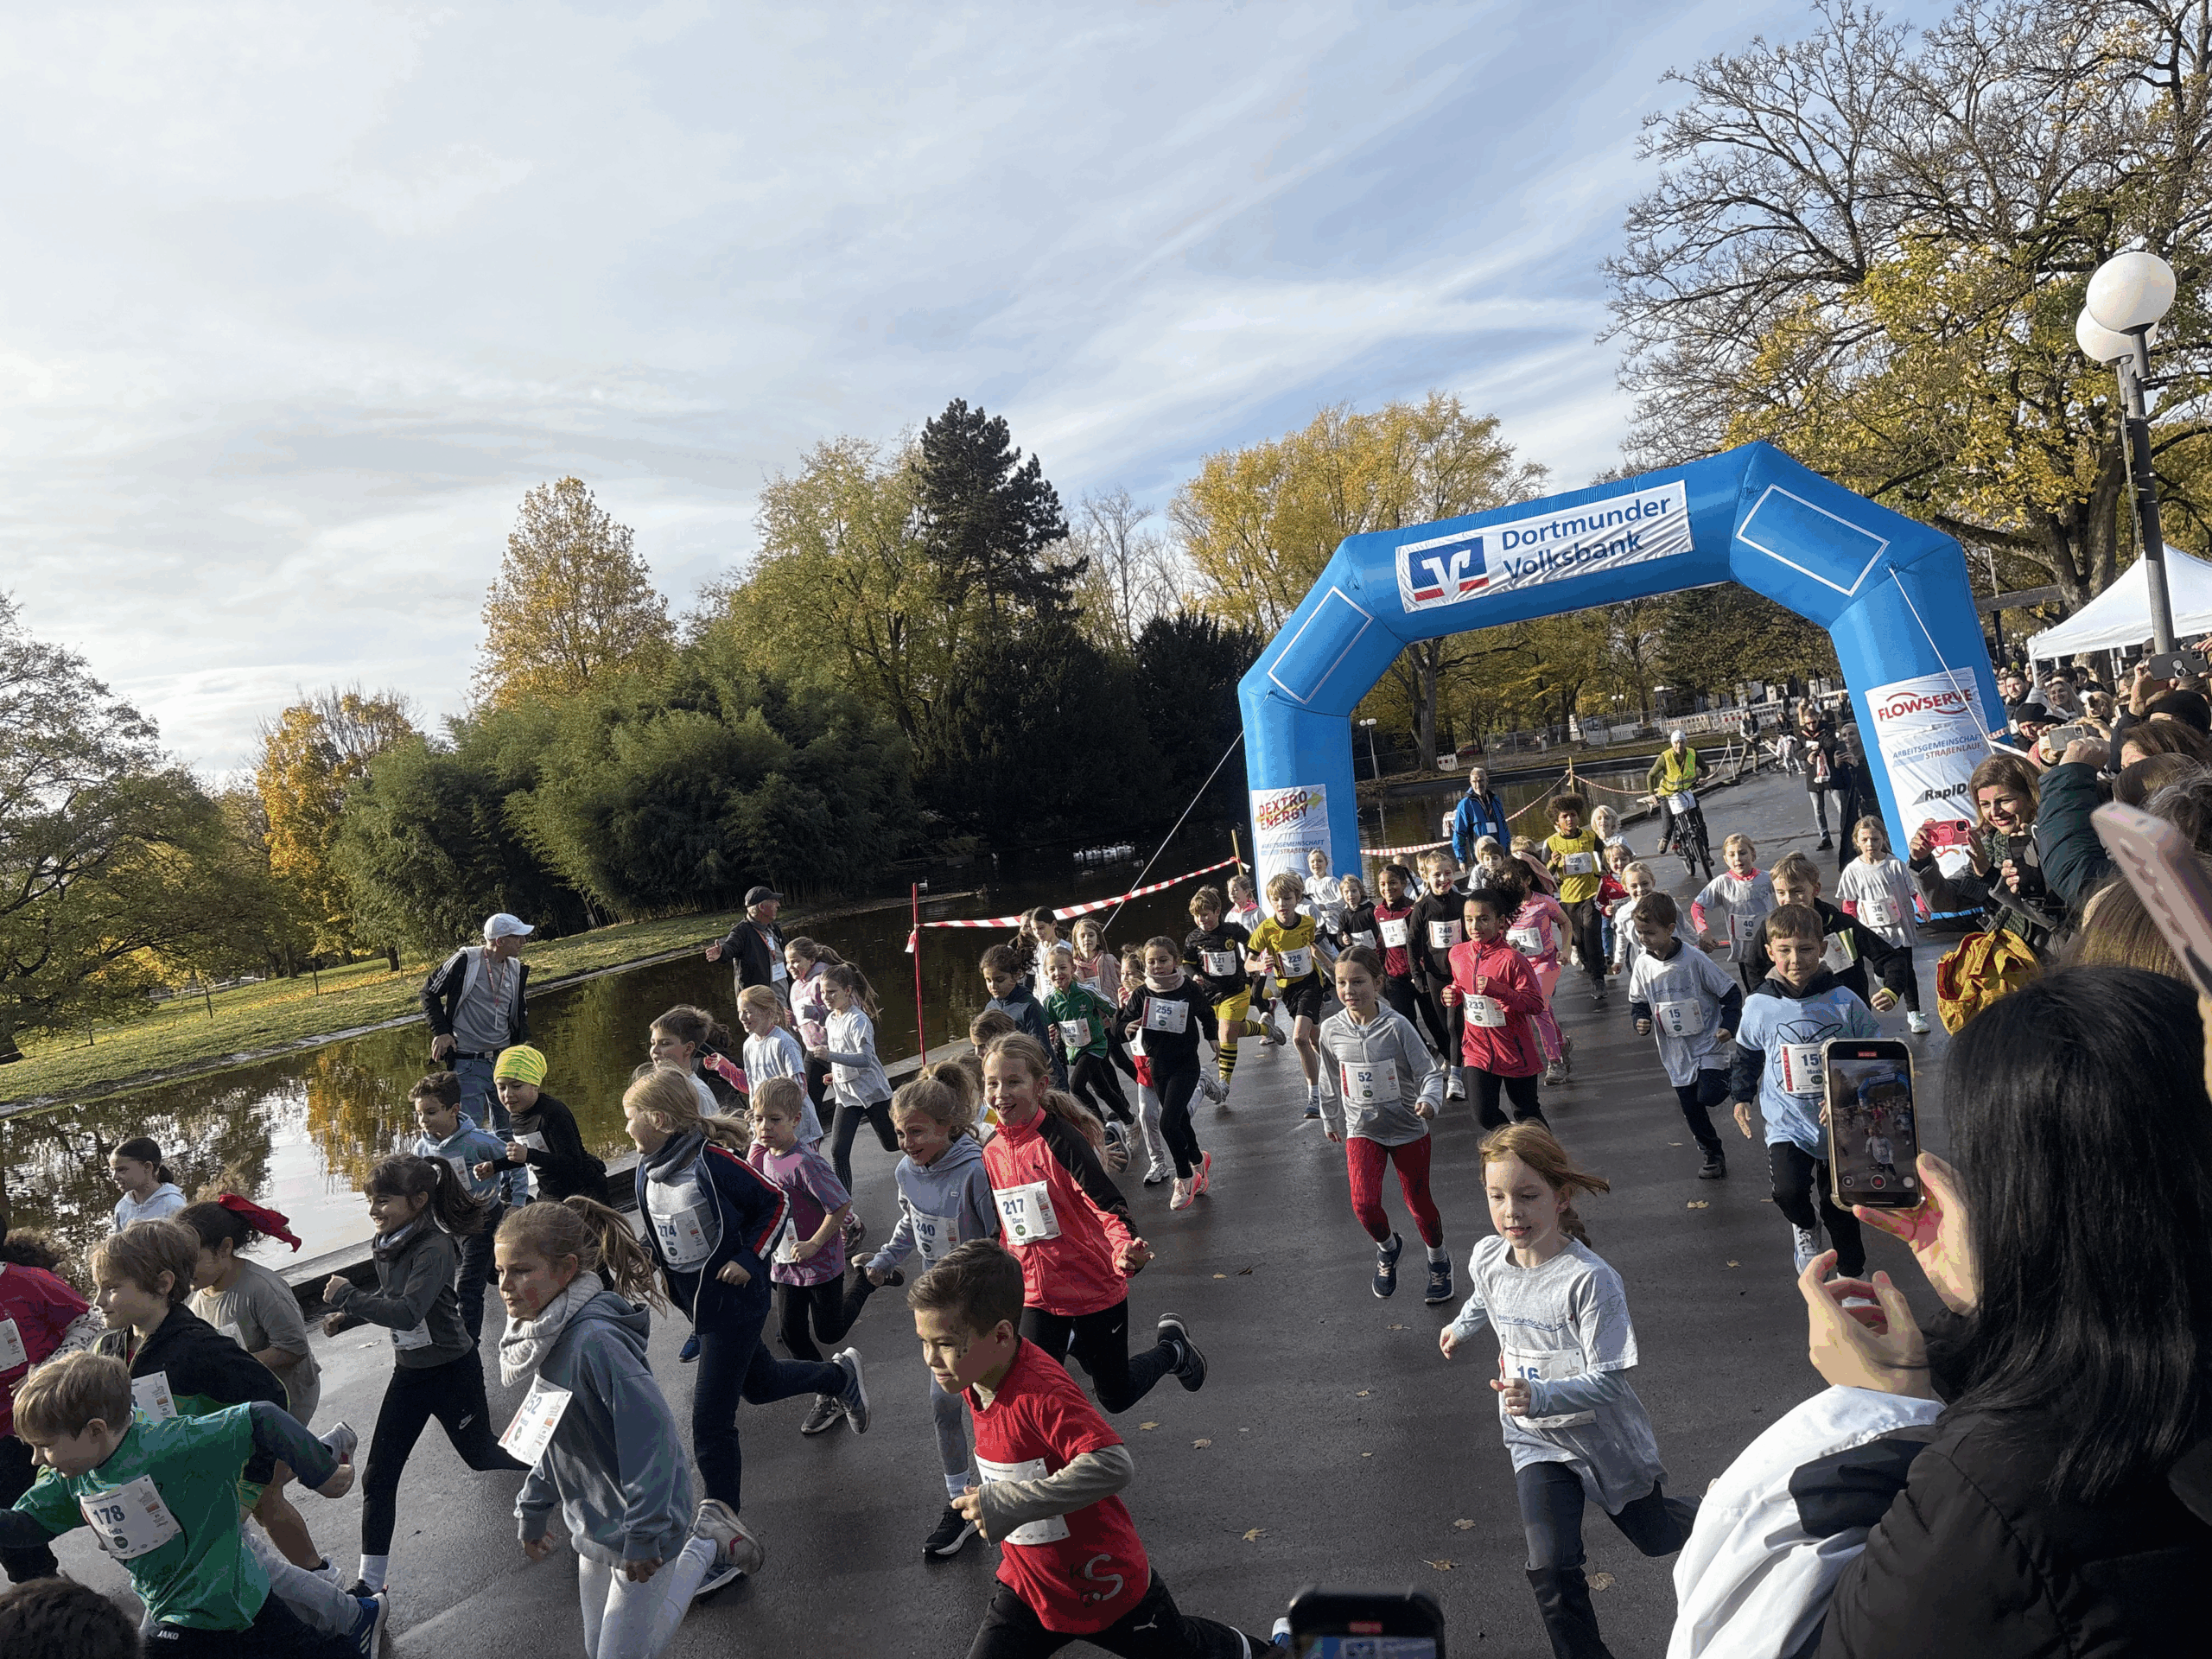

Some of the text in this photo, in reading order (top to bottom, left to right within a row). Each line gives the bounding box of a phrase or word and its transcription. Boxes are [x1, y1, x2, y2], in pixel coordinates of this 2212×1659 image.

[1503, 496, 1671, 551] Dortmunder
[1503, 531, 1644, 580] Volksbank
[1878, 689, 1974, 721] FLOWSERVE
[1892, 734, 1983, 759] ARBEITSGEMEINSCHAFT
[1258, 791, 1308, 817] DEXTRO
[1260, 803, 1309, 830] ENERGY
[1871, 905, 1883, 913] 38
[1156, 1005, 1173, 1015] 255
[1467, 1000, 1485, 1010] 233
[1669, 1008, 1681, 1019] 15
[1801, 1053, 1822, 1066] 15
[1357, 1071, 1373, 1083] 52
[1002, 1198, 1025, 1216] 217
[658, 1224, 677, 1238] 274
[915, 1218, 936, 1236] 240
[1516, 1365, 1541, 1381] 16
[92, 1504, 125, 1526] 178
[156, 1630, 180, 1641] JAKO
